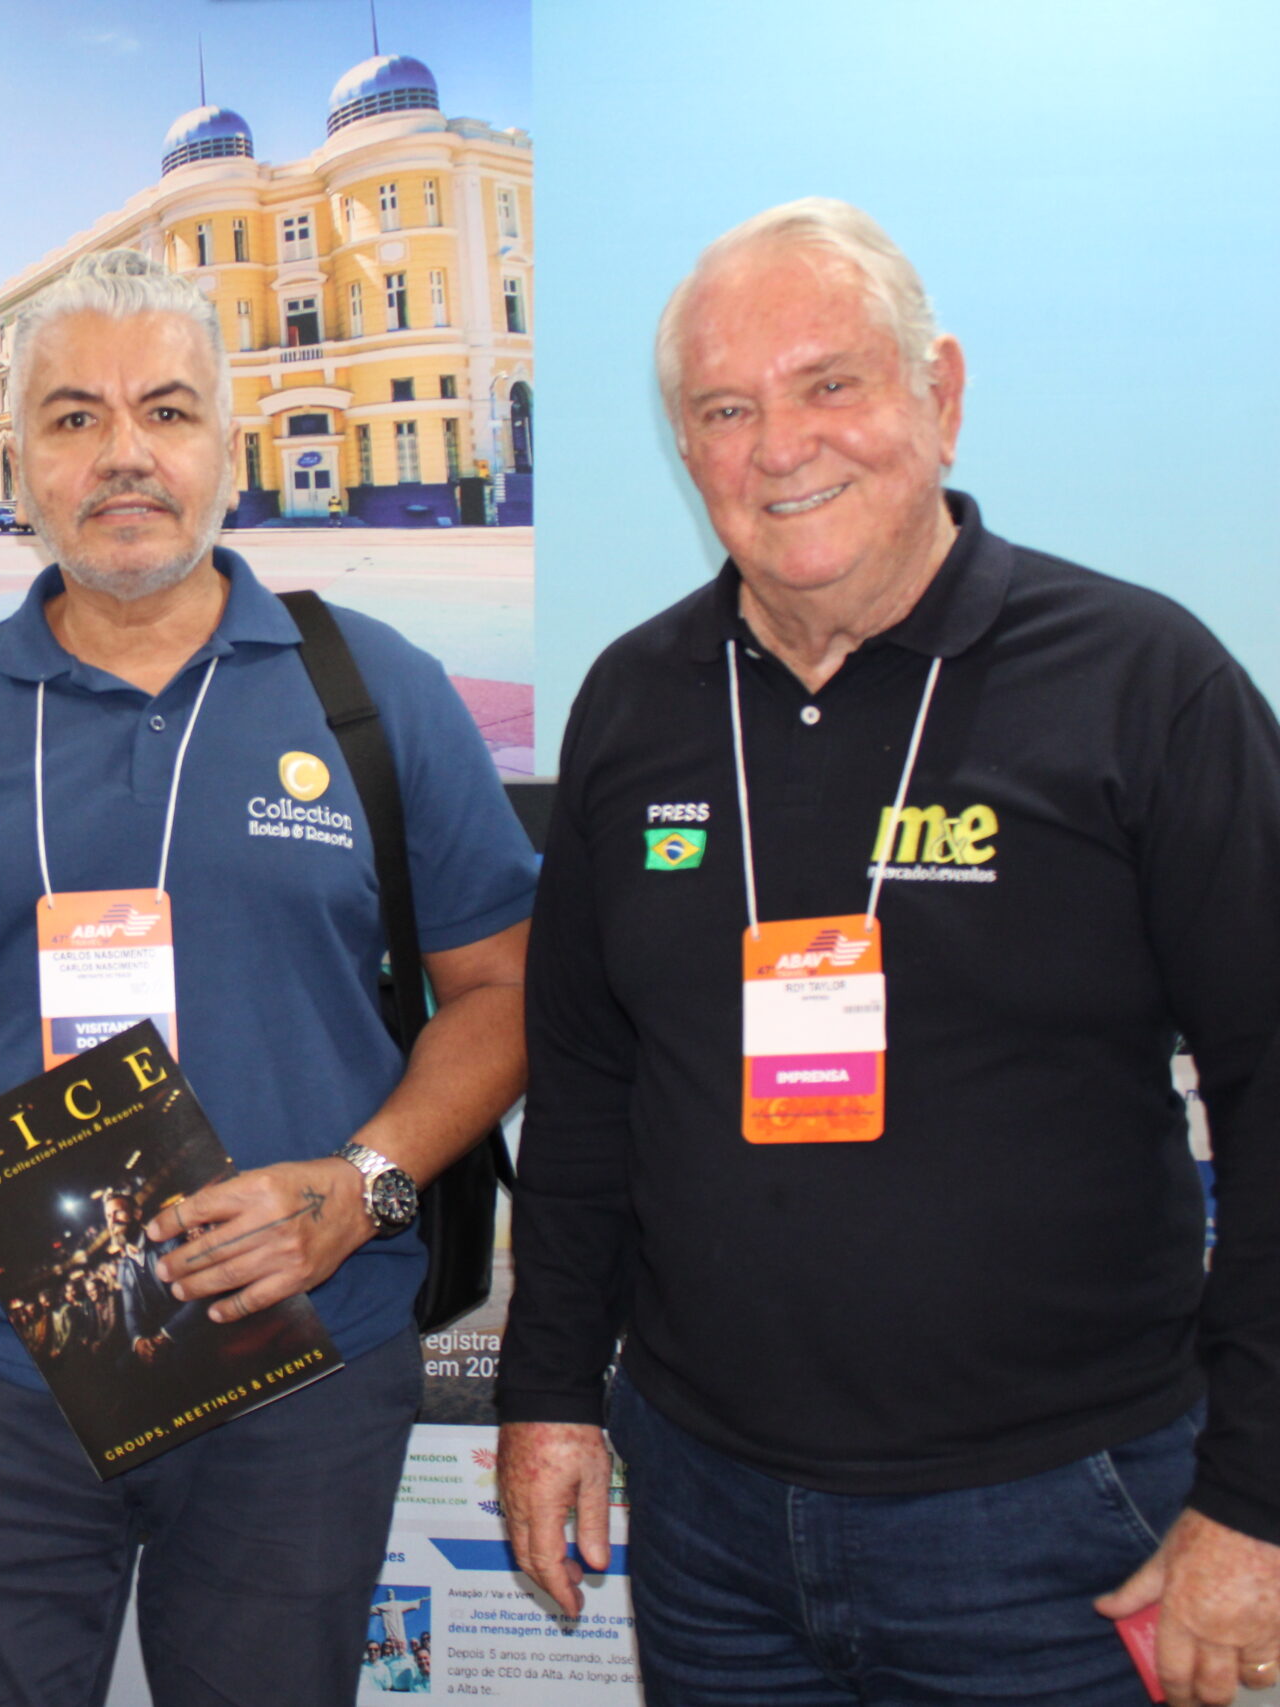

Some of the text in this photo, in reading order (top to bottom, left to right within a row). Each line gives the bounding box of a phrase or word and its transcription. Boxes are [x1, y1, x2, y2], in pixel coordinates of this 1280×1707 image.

[247, 796, 353, 832] Collection
[647, 803, 711, 823] PRESS
[249, 820, 291, 838] Hotels
[305, 825, 354, 850] Resorts
[870, 803, 999, 865] m&e
[71, 924, 116, 938] ABAV
[53, 948, 156, 961] CARLOS NASCIMENTO
[60, 962, 93, 973] CARLOS
[776, 1069, 850, 1085] IMPRENSA
[3, 1146, 58, 1179] Collection
[58, 1128, 92, 1151] Hotels
[93, 1122, 102, 1133] &
[104, 1101, 145, 1127] Resorts
[425, 1360, 460, 1377] em
[172, 1385, 248, 1429] MEETINGS
[250, 1379, 262, 1391] &
[265, 1348, 325, 1384] EVENTS
[409, 1453, 458, 1463] NEGÓCIOS
[448, 1588, 482, 1600] Aviação
[491, 1589, 504, 1599] Vai
[506, 1591, 513, 1599] e
[515, 1590, 535, 1599] Vem
[470, 1608, 497, 1620] José
[500, 1610, 541, 1622] Ricardo
[545, 1614, 558, 1622] se
[592, 1613, 607, 1624] do
[448, 1623, 619, 1640] deixa mensagem de despedida
[448, 1647, 485, 1660] Depois
[489, 1648, 497, 1659] 5
[500, 1651, 527, 1660] anos
[530, 1652, 545, 1661] no
[448, 1667, 479, 1678] cargo
[481, 1667, 495, 1677] de
[498, 1667, 521, 1678] CEO
[524, 1668, 538, 1679] da
[569, 1670, 584, 1681] Ao
[588, 1670, 618, 1684] longo
[621, 1672, 634, 1683] de
[448, 1685, 455, 1694] a
[457, 1684, 478, 1695] Alta
